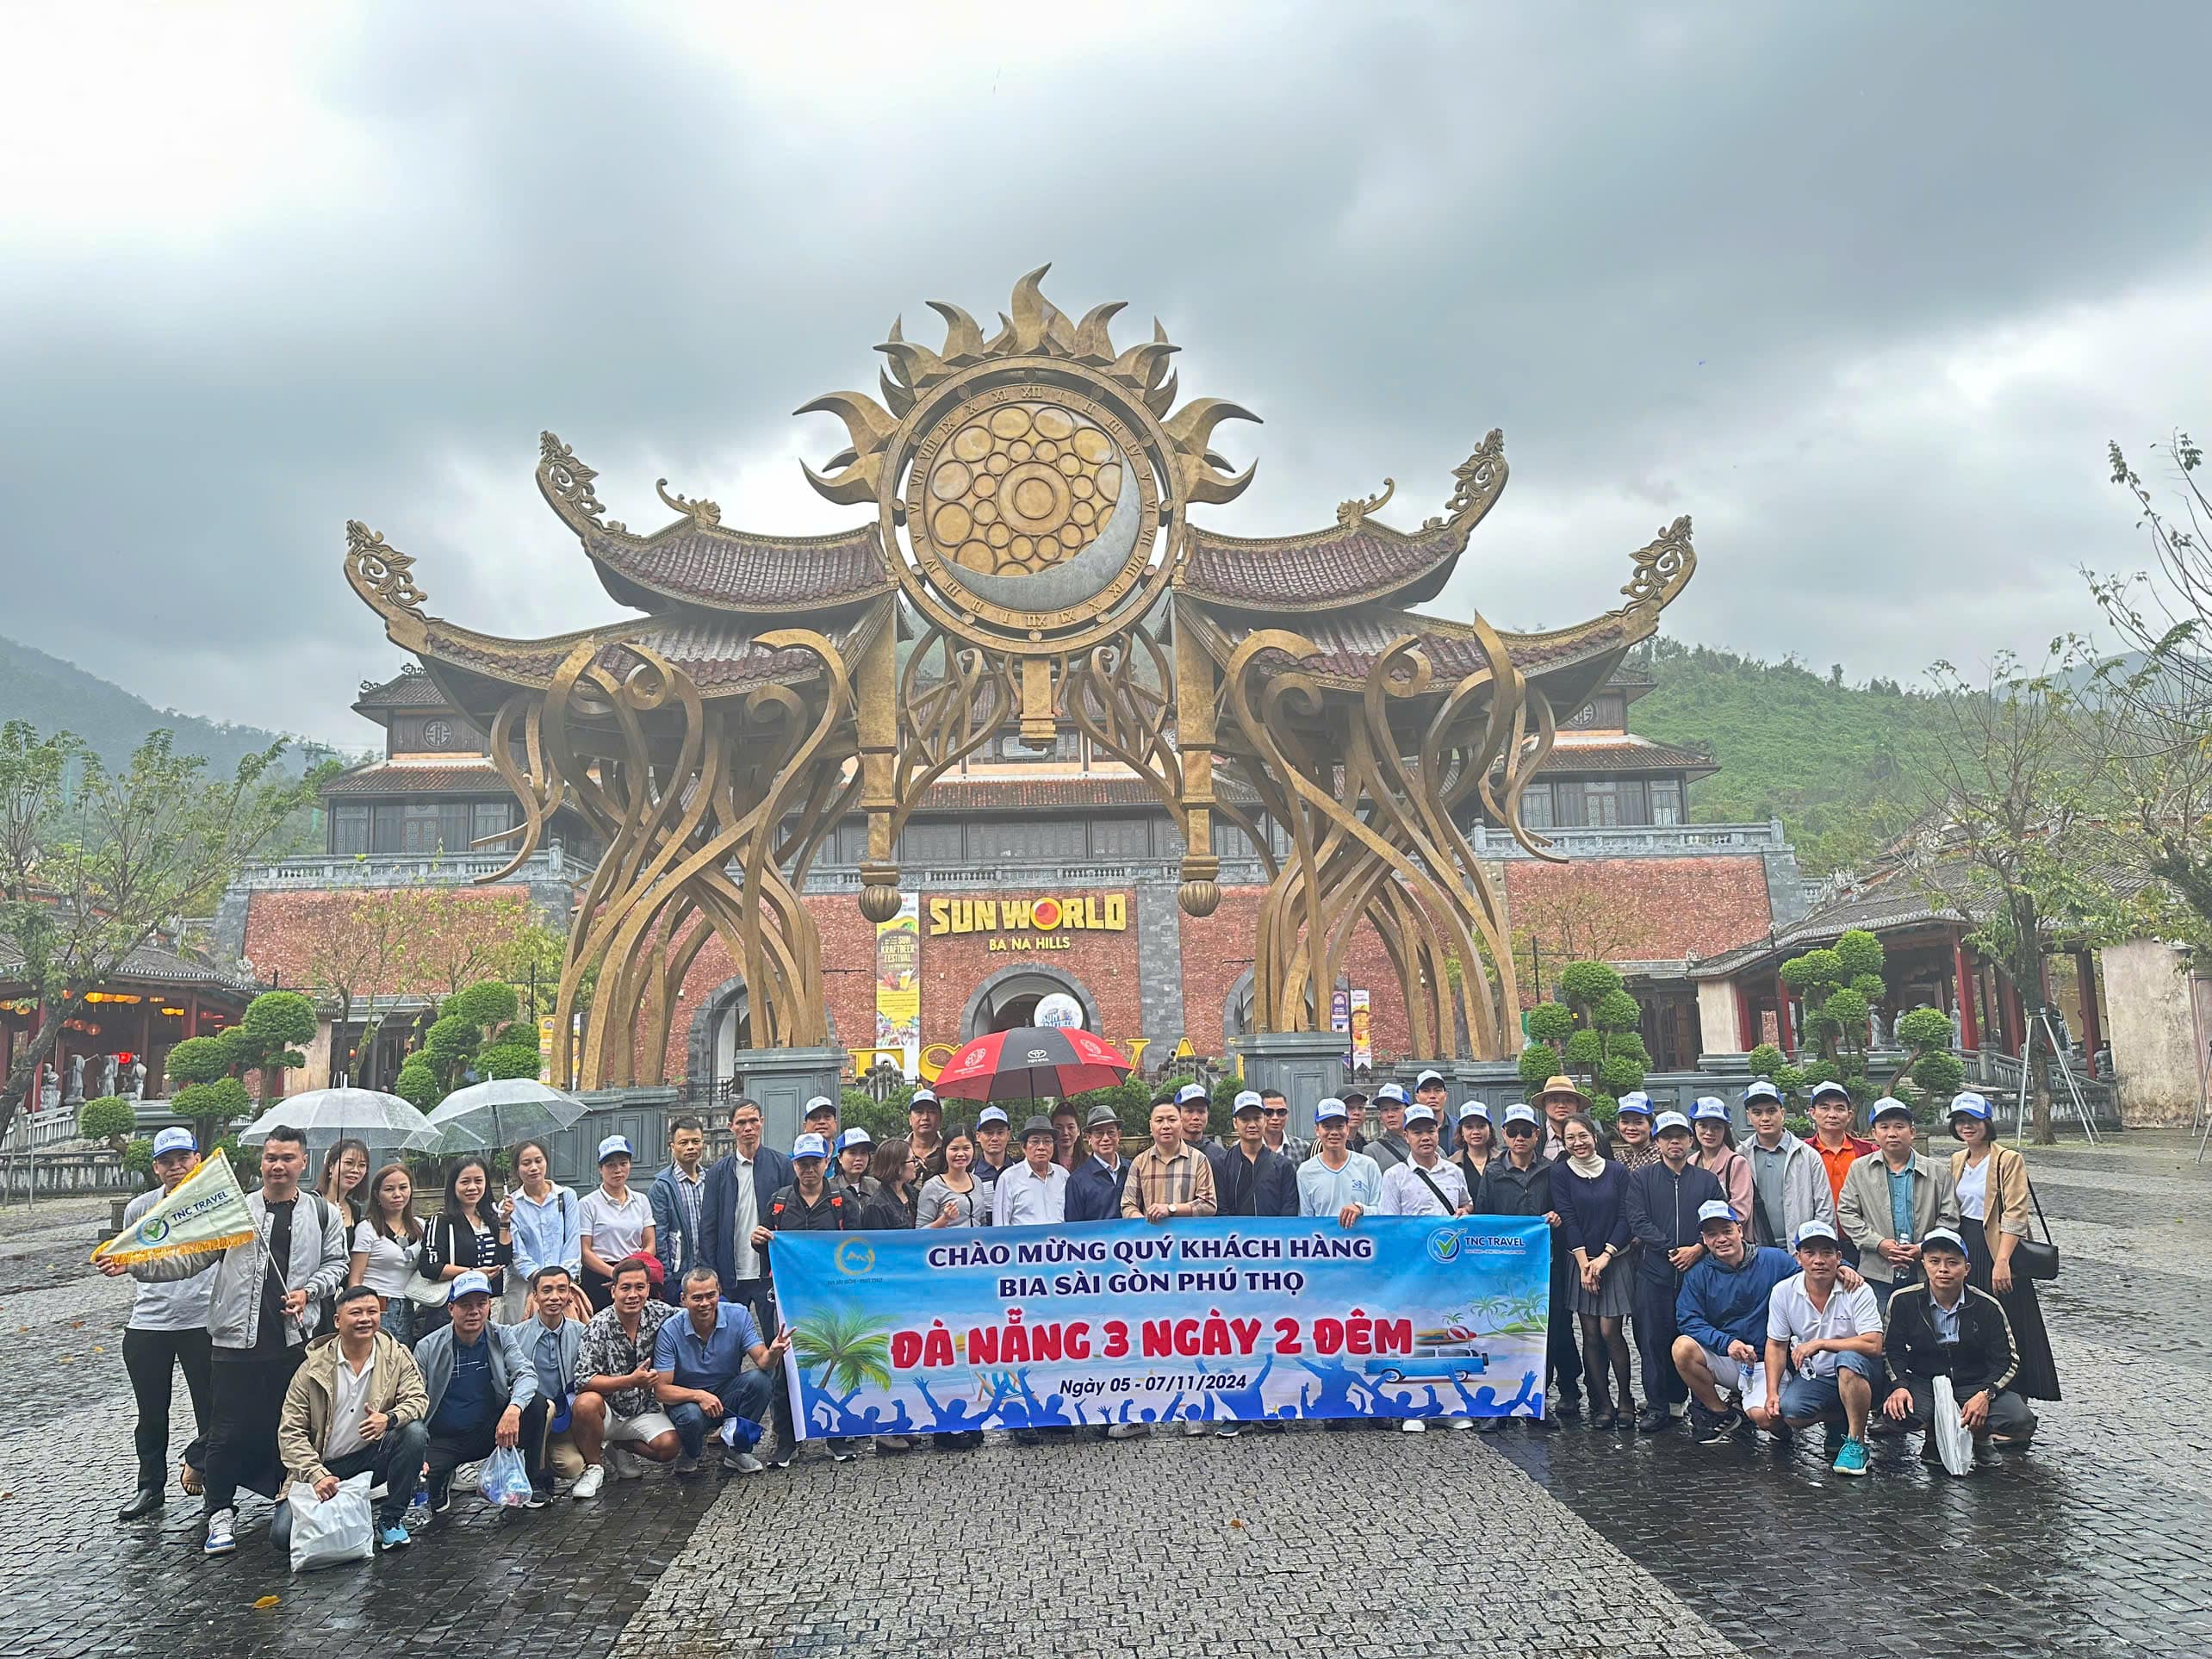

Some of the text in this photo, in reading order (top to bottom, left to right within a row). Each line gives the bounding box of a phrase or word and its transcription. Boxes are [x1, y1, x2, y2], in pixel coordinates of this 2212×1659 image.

[989, 937, 1071, 951] BA NA HILLS
[884, 954, 911, 963] FESTIVAL
[171, 1207, 192, 1221] TNC
[193, 1191, 228, 1210] TRAVEL
[929, 1233, 1372, 1267] CHÀO MỪNG QUÝ KHÁCH HÀNG
[1465, 1237, 1525, 1247] TNC TRAVEL
[999, 1267, 1304, 1297] BIA SÀI GÒN PHÚ THỌ
[891, 1308, 1413, 1368] ĐÀ NẴNG 3 NGÀY 2 ĐÊM
[1059, 1378, 1105, 1398] Ngày
[1109, 1377, 1130, 1392] 05
[1145, 1375, 1247, 1393] 07/11/2024
